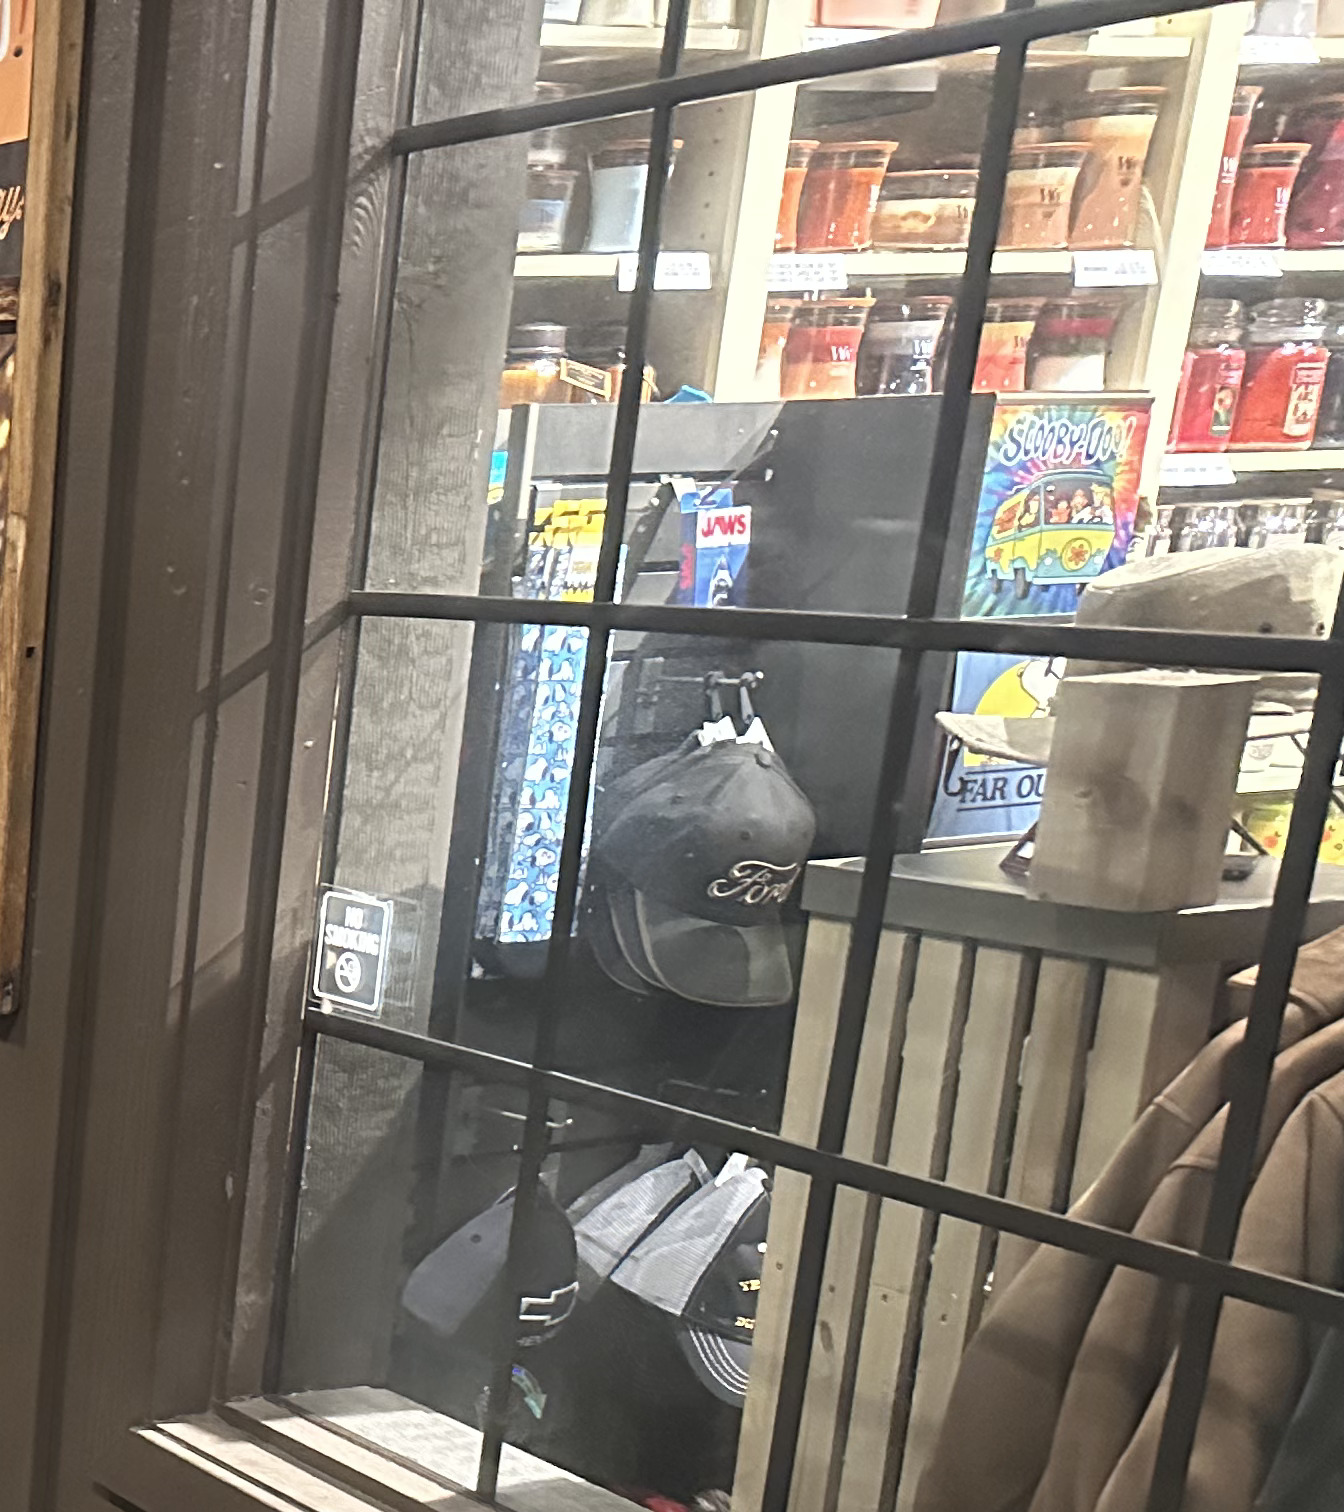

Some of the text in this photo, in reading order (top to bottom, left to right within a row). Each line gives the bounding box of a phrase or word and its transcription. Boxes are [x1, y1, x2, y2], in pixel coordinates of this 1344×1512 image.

[701, 513, 747, 537] JAWS
[958, 777, 1008, 803] FAR
[707, 860, 801, 904] Ford
[345, 905, 364, 929] NO
[324, 923, 380, 956] SMOKING
